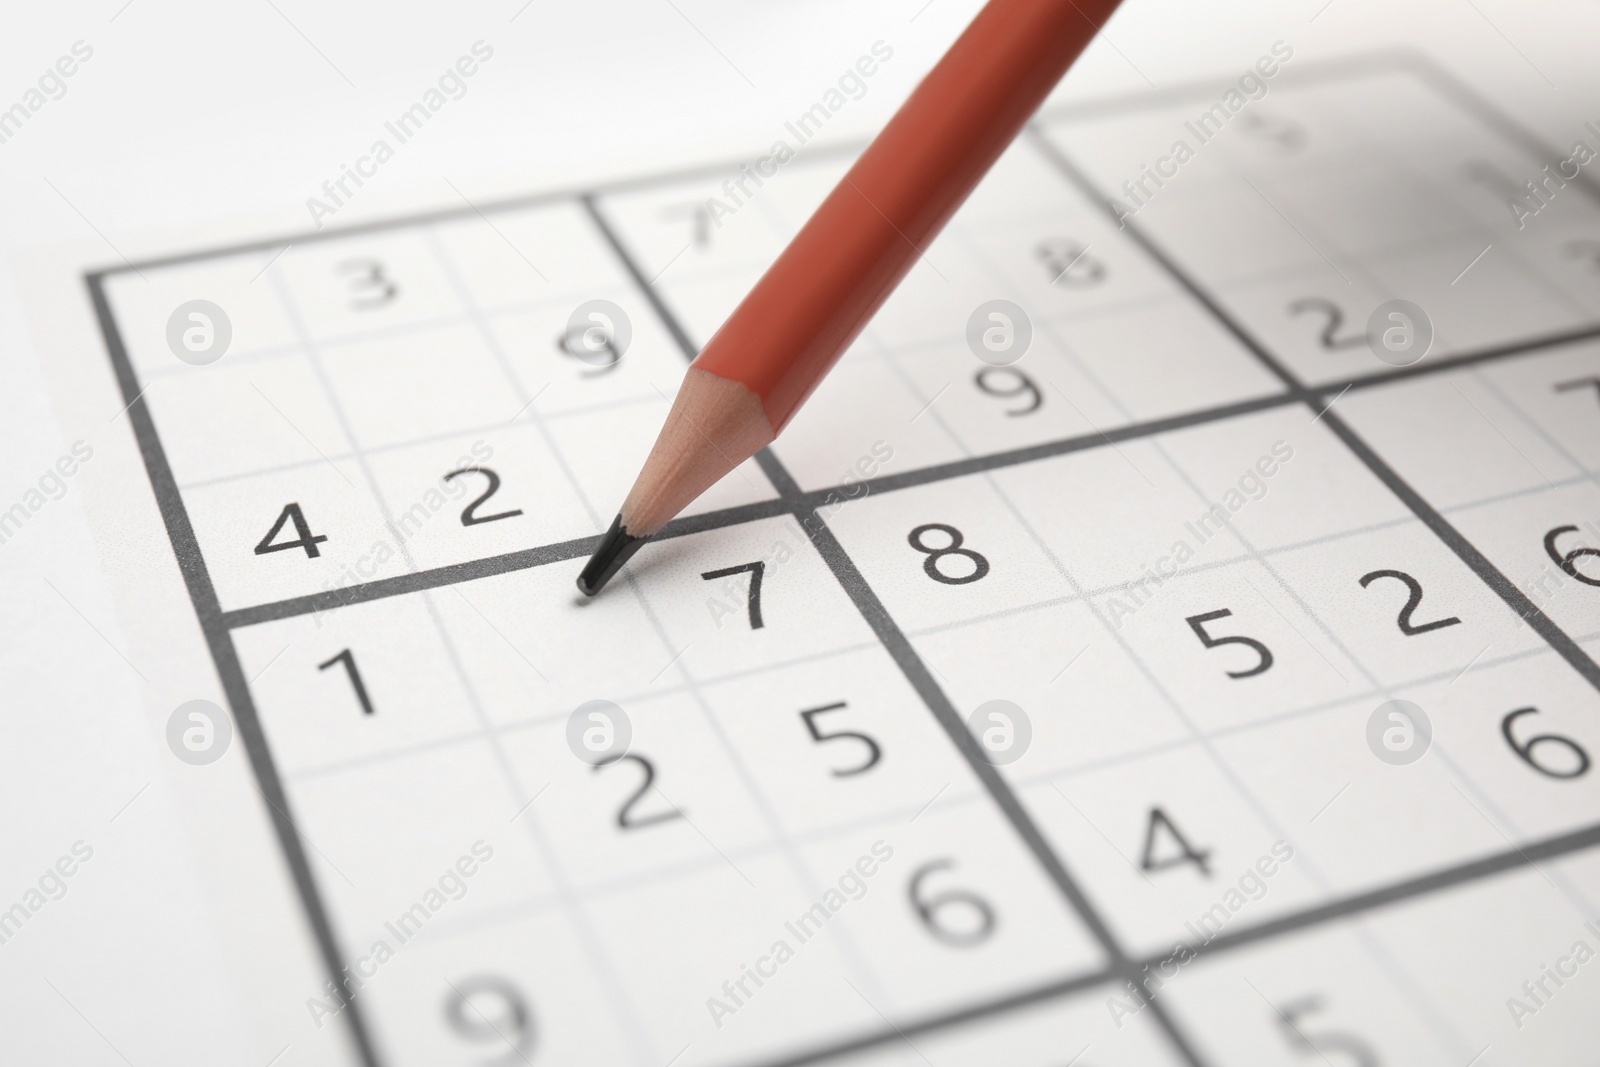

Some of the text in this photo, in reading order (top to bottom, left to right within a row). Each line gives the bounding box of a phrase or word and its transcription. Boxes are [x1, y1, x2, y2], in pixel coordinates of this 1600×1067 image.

[336, 256, 400, 312] 3
[556, 325, 624, 379] 9
[1288, 297, 1374, 353] 2
[973, 365, 1044, 417] 9
[253, 502, 328, 559] 4
[443, 467, 523, 527] 2
[907, 523, 990, 586] 8
[701, 560, 765, 630] 7
[1358, 569, 1462, 636] 2
[1185, 608, 1274, 680] 5
[318, 648, 375, 716] 1
[799, 701, 883, 778] 5
[1500, 706, 1592, 781] 6
[591, 751, 684, 832] 2
[1137, 806, 1213, 878] 4
[905, 858, 1000, 949] 6
[440, 974, 540, 1067] 9
